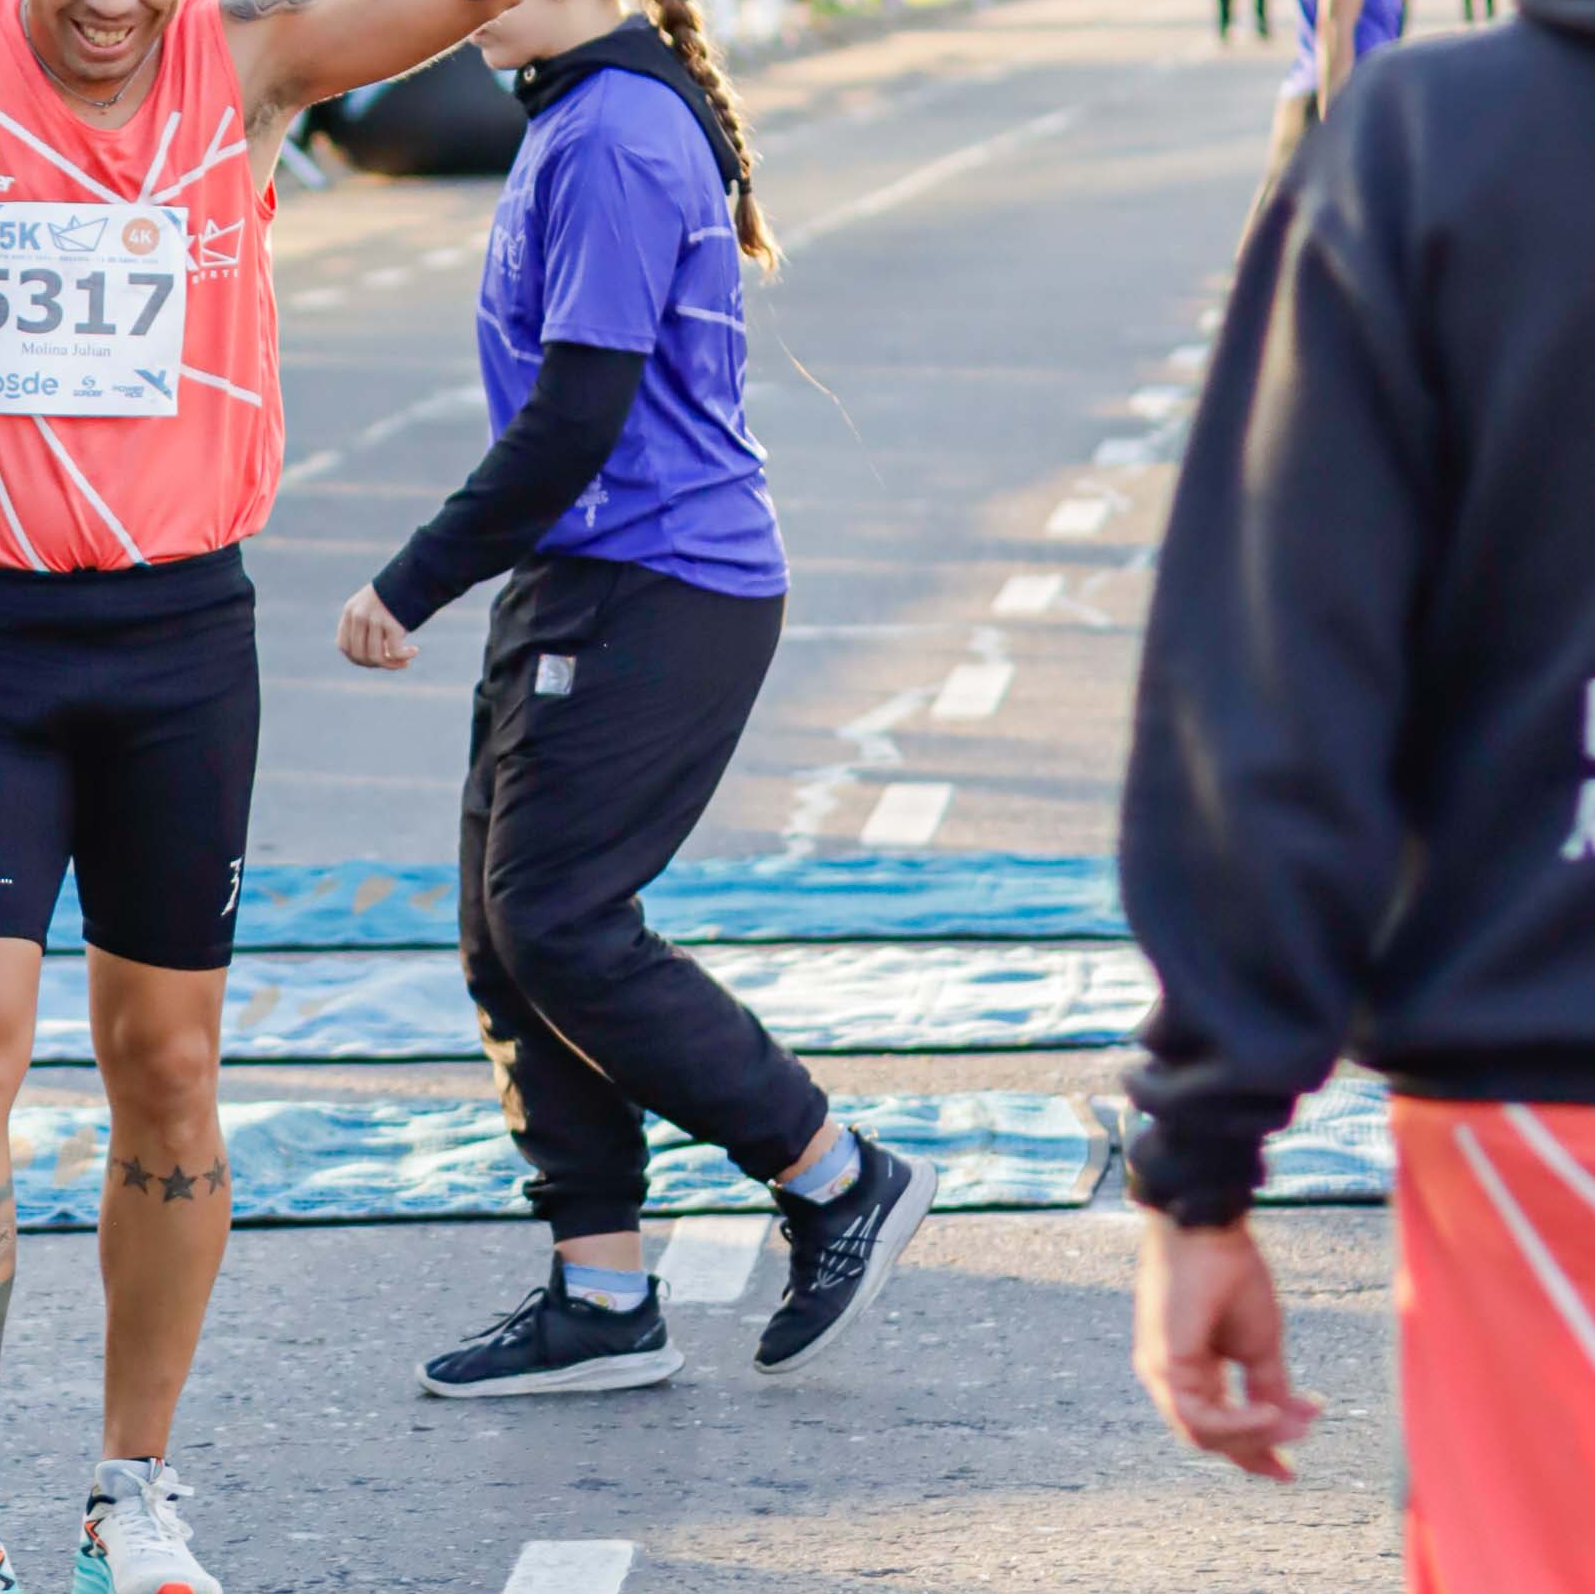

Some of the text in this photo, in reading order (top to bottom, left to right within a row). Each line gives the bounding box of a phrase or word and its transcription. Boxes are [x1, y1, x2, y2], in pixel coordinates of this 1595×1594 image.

[128, 228, 152, 244] 4K
[21, 341, 112, 358] Molina Julian
